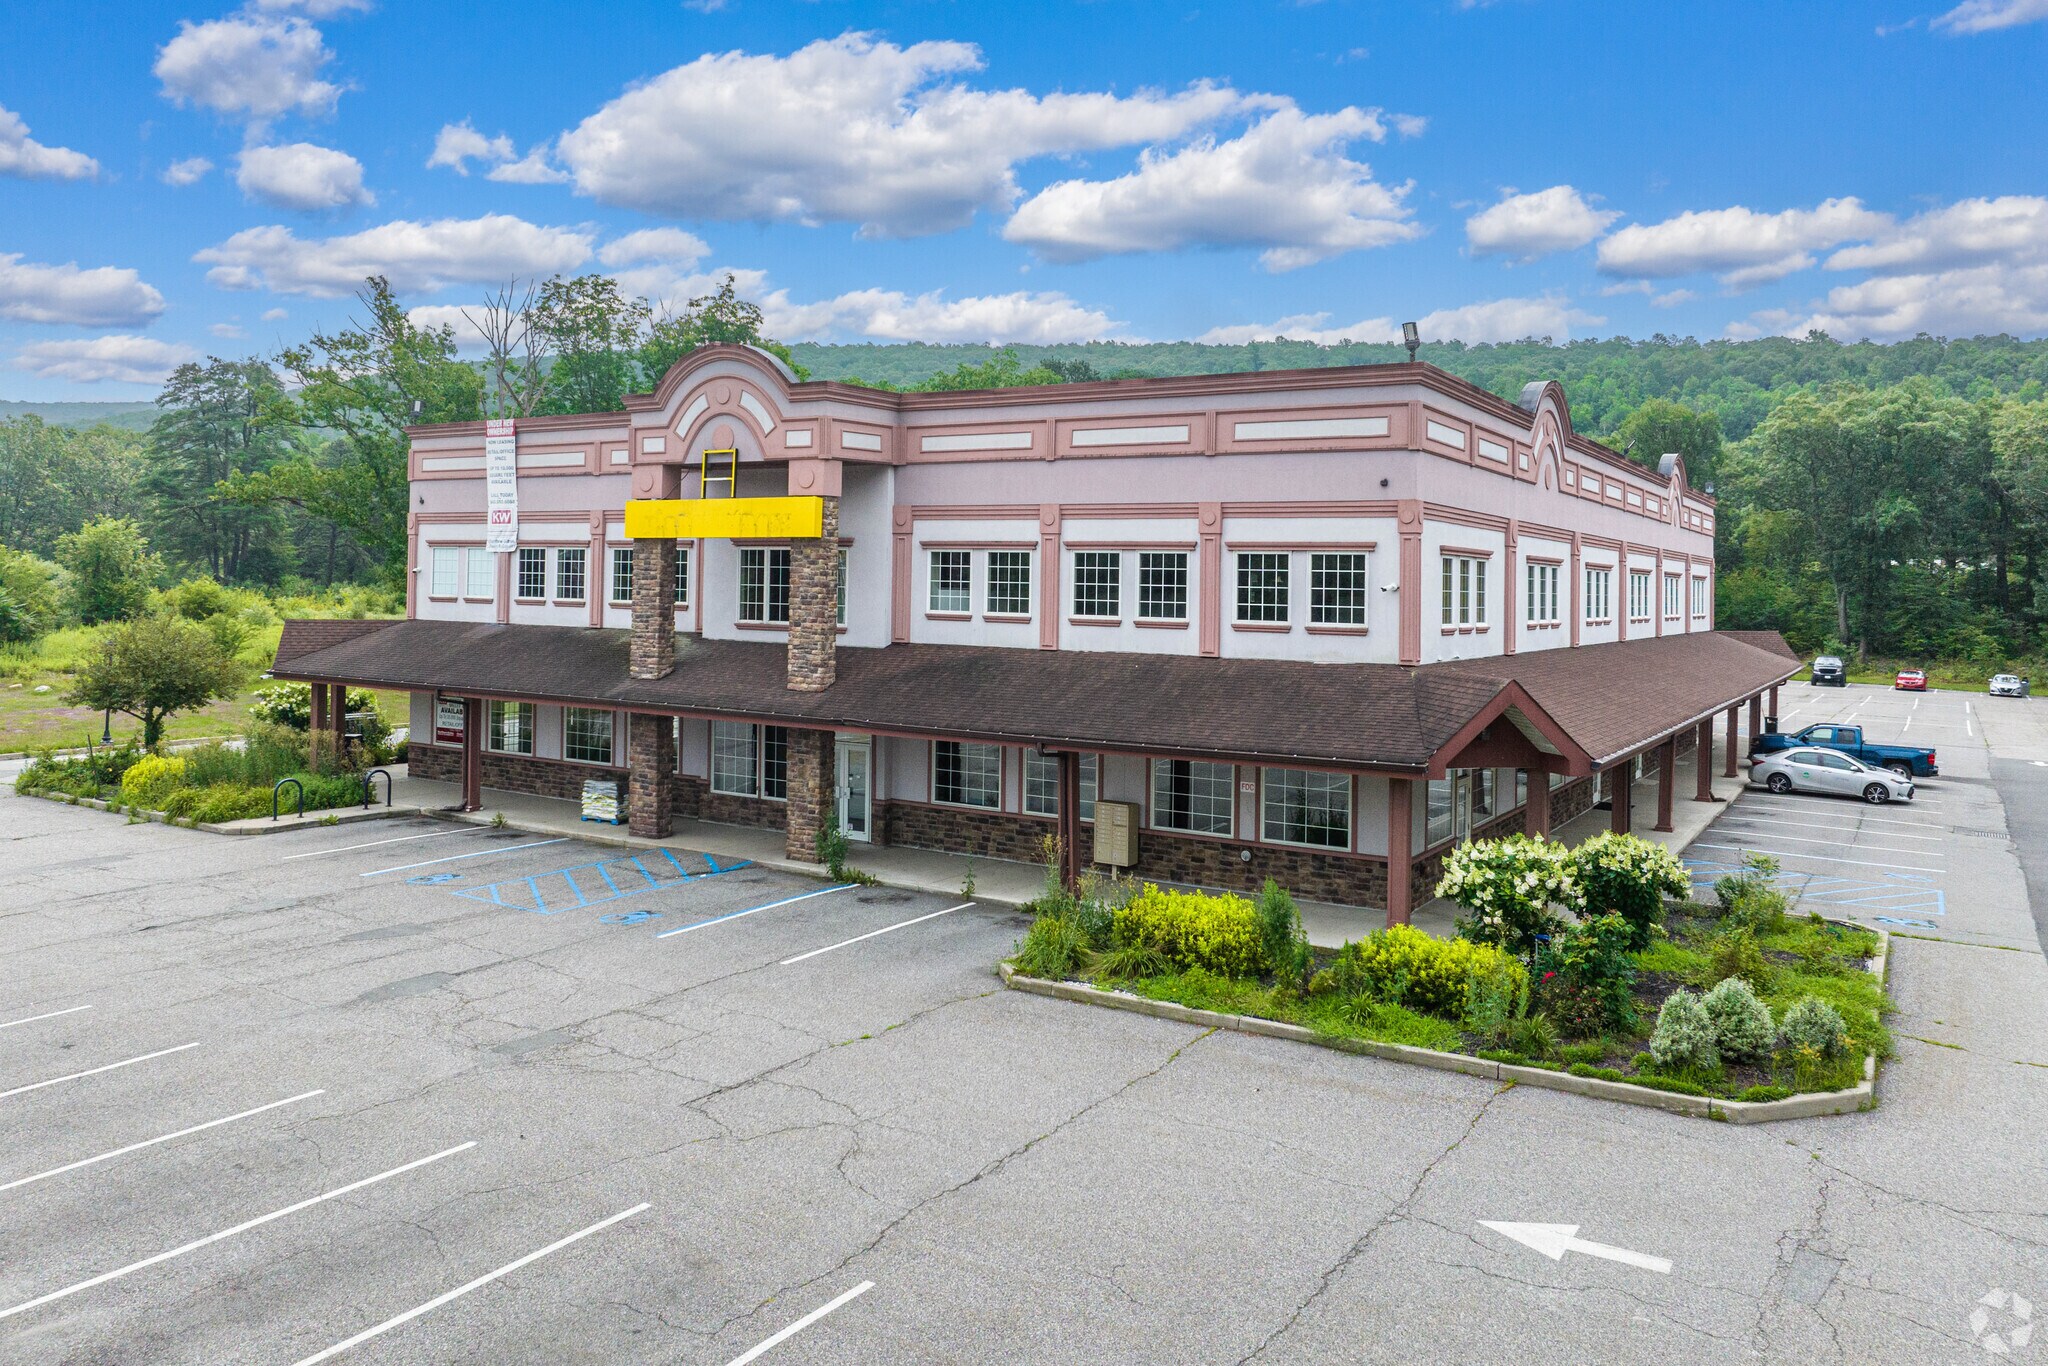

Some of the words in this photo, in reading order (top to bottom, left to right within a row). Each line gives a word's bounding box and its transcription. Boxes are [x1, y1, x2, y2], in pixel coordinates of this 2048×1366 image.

[487, 419, 502, 427] UNDER
[503, 419, 514, 427] NEW
[487, 428, 514, 436] OWNERSHIP
[492, 512, 511, 523] KW
[441, 707, 463, 715] AVAILAB
[1241, 783, 1255, 791] FDC
